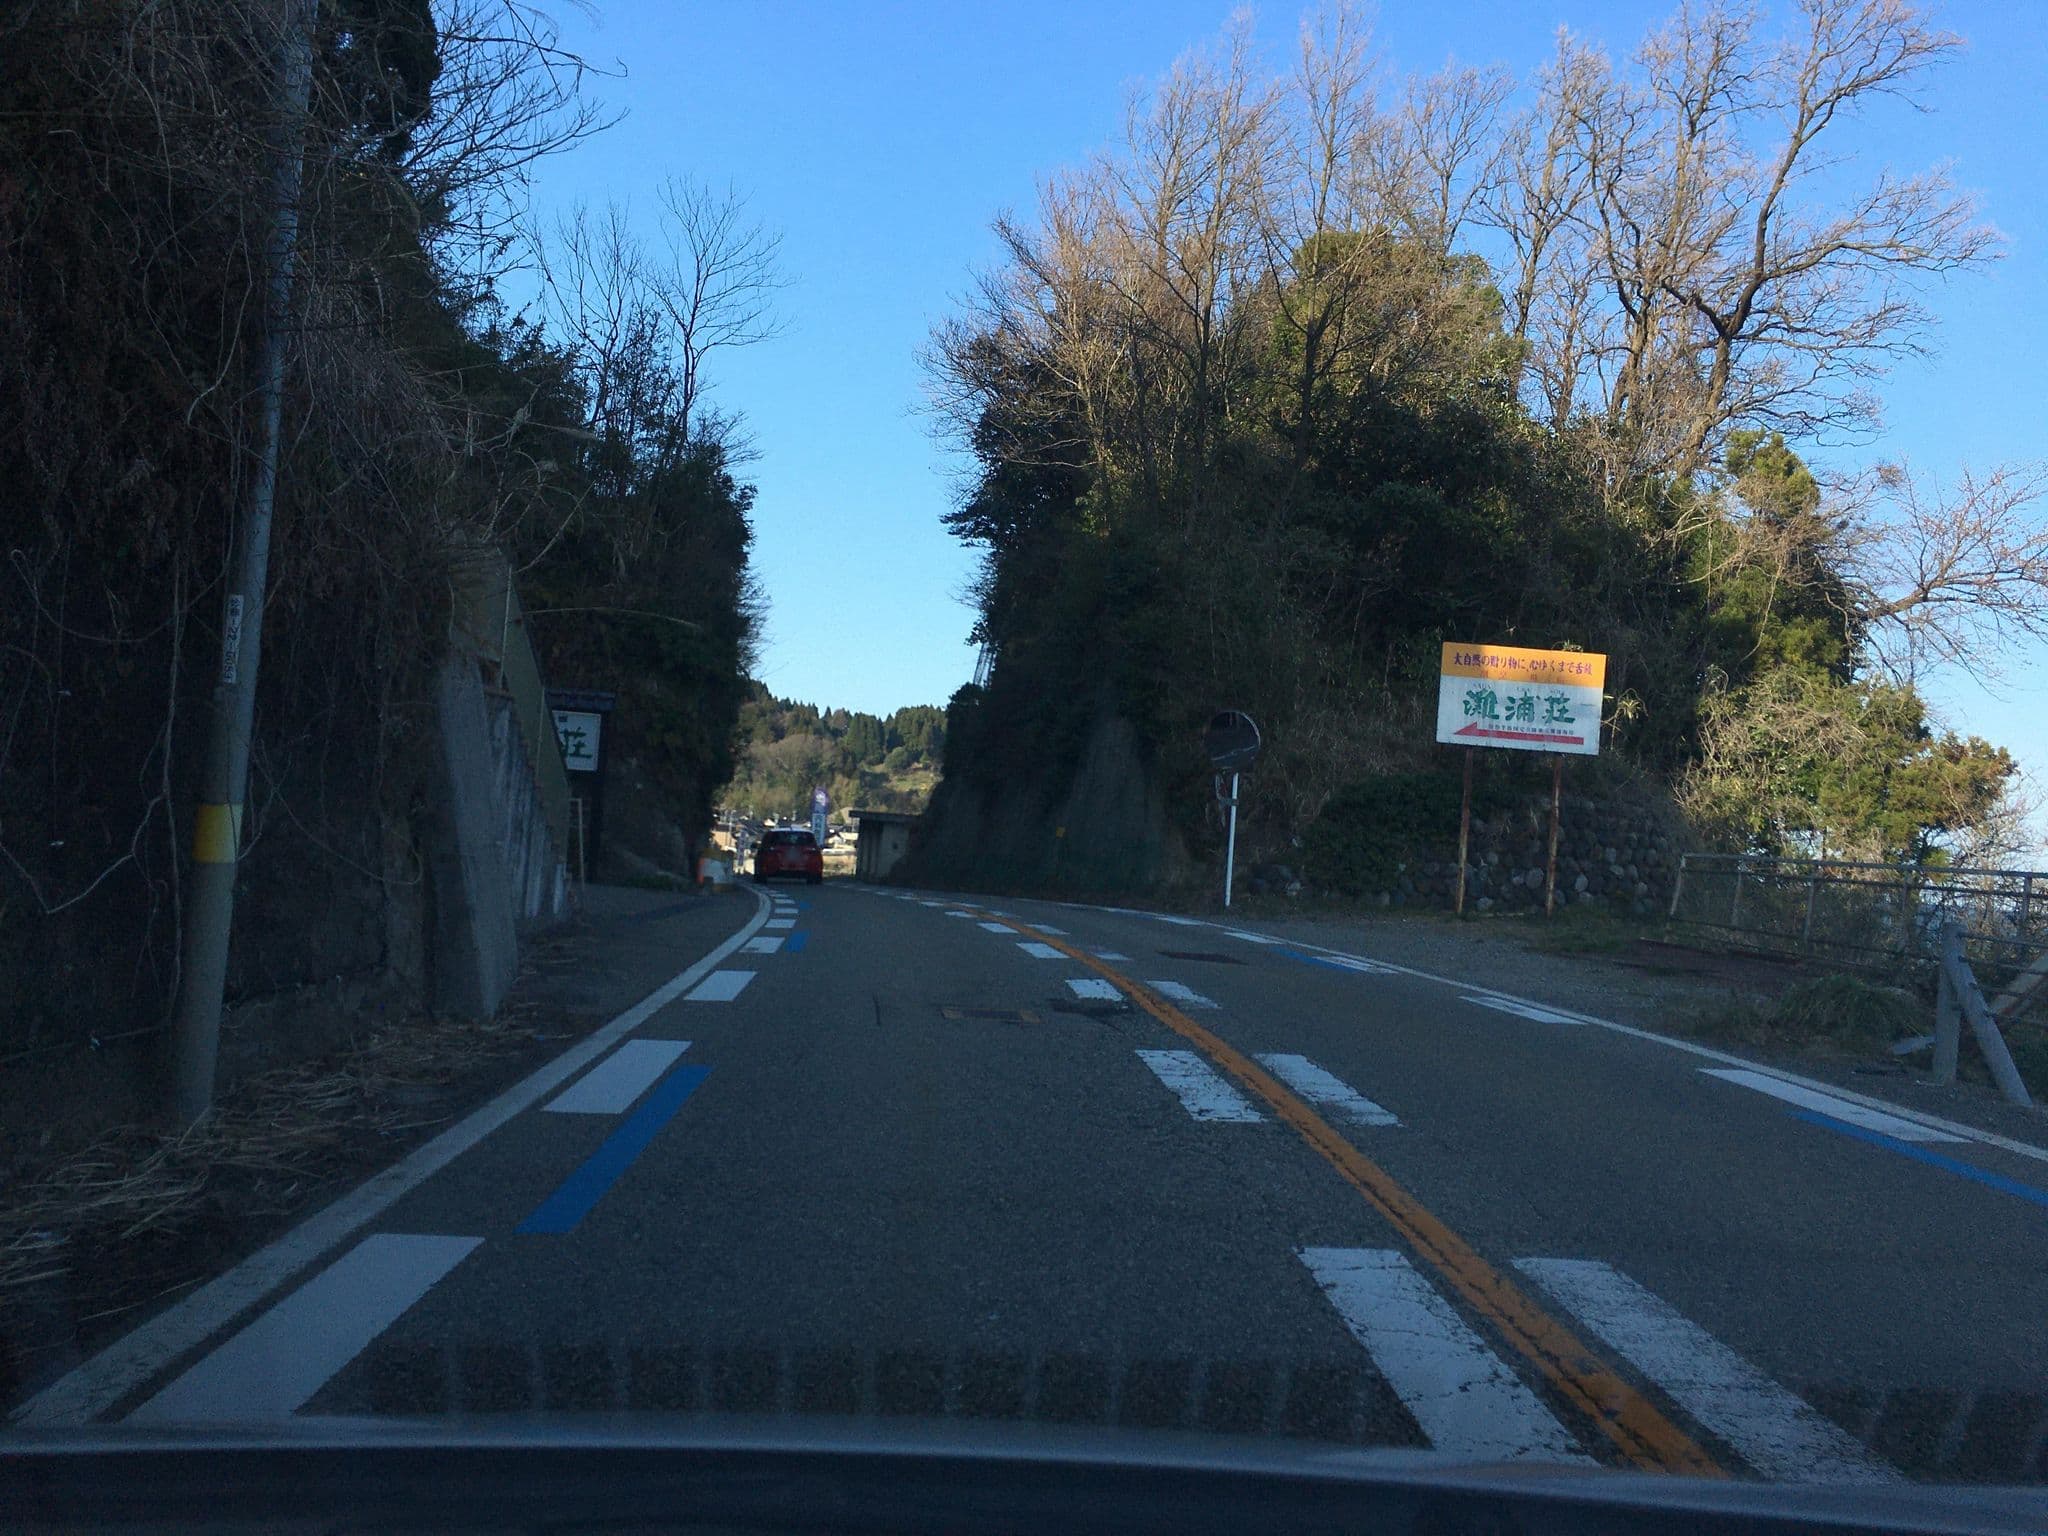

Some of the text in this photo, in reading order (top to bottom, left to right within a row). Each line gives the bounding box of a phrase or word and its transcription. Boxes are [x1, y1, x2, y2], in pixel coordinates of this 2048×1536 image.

[1462, 688, 1576, 724] 灘浦荘
[559, 726, 593, 758] 荘
